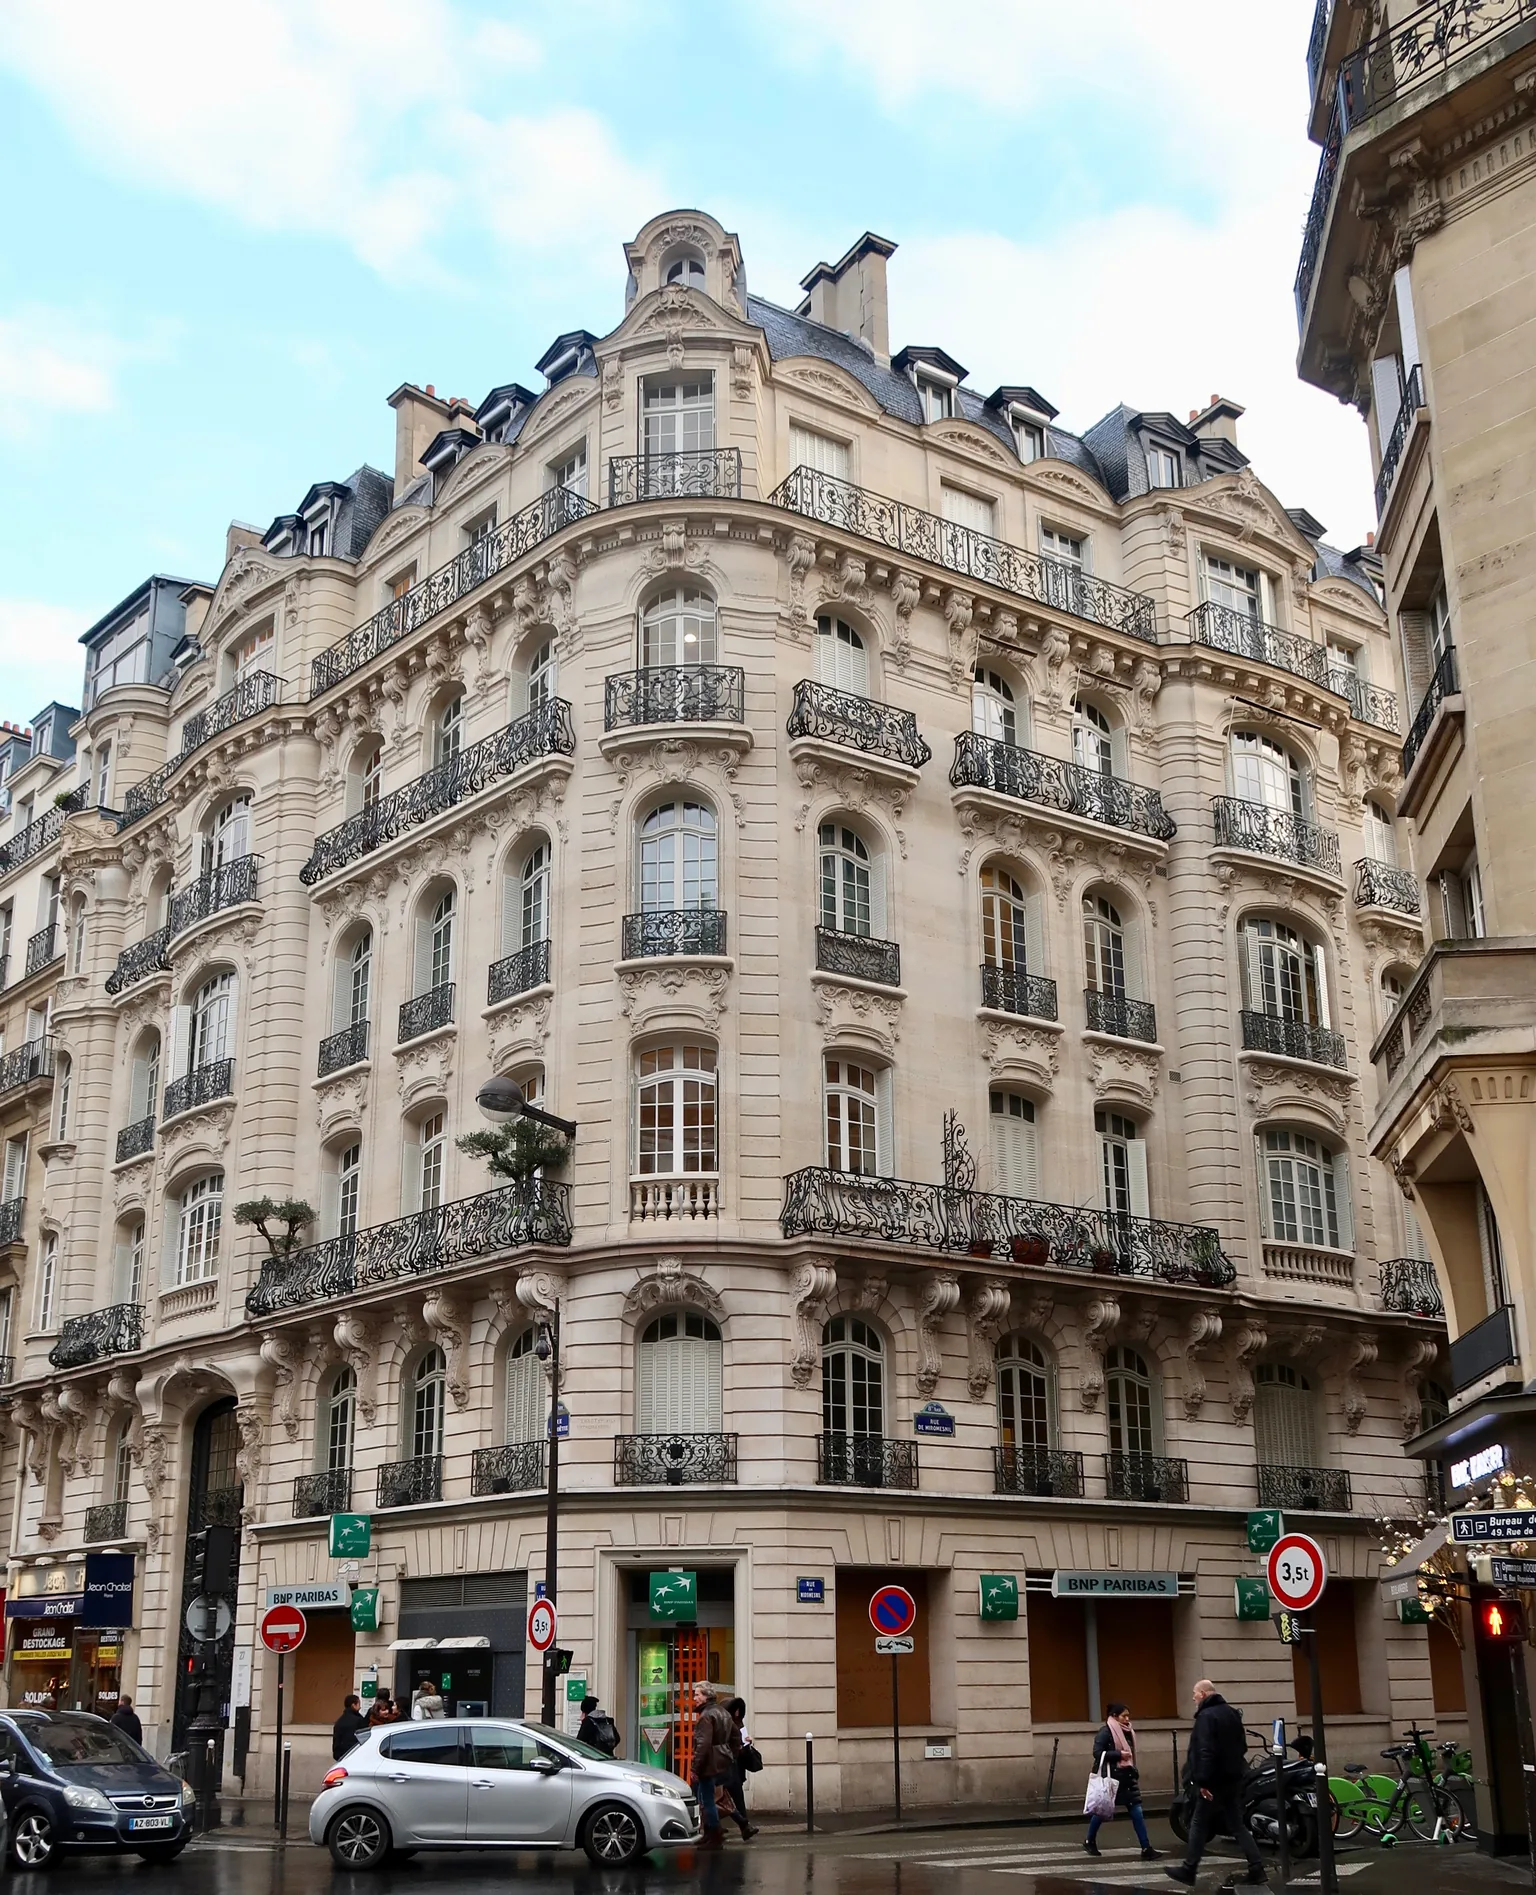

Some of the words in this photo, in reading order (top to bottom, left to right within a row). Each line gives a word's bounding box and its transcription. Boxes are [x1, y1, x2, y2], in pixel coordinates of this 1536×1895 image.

[1490, 1516, 1522, 1526] Bureau
[1528, 1514, 1536, 1524] d
[1506, 1528, 1521, 1536] Rue
[1524, 1527, 1534, 1535] de
[1282, 1562, 1309, 1584] 3,5t
[87, 1582, 106, 1592] Jean
[106, 1582, 132, 1592] Chatel
[1068, 1578, 1099, 1590] BNP
[1104, 1579, 1166, 1592] PARIBAS
[273, 1594, 292, 1604] BNP
[296, 1590, 338, 1602] PARIBAS
[44, 1602, 57, 1614] Jean
[56, 1602, 75, 1614] Chatel
[534, 1619, 548, 1634] 3,5t
[33, 1628, 55, 1638] GRAND
[23, 1638, 65, 1648] DESTOCKAGE
[98, 1692, 118, 1700] SOLDES
